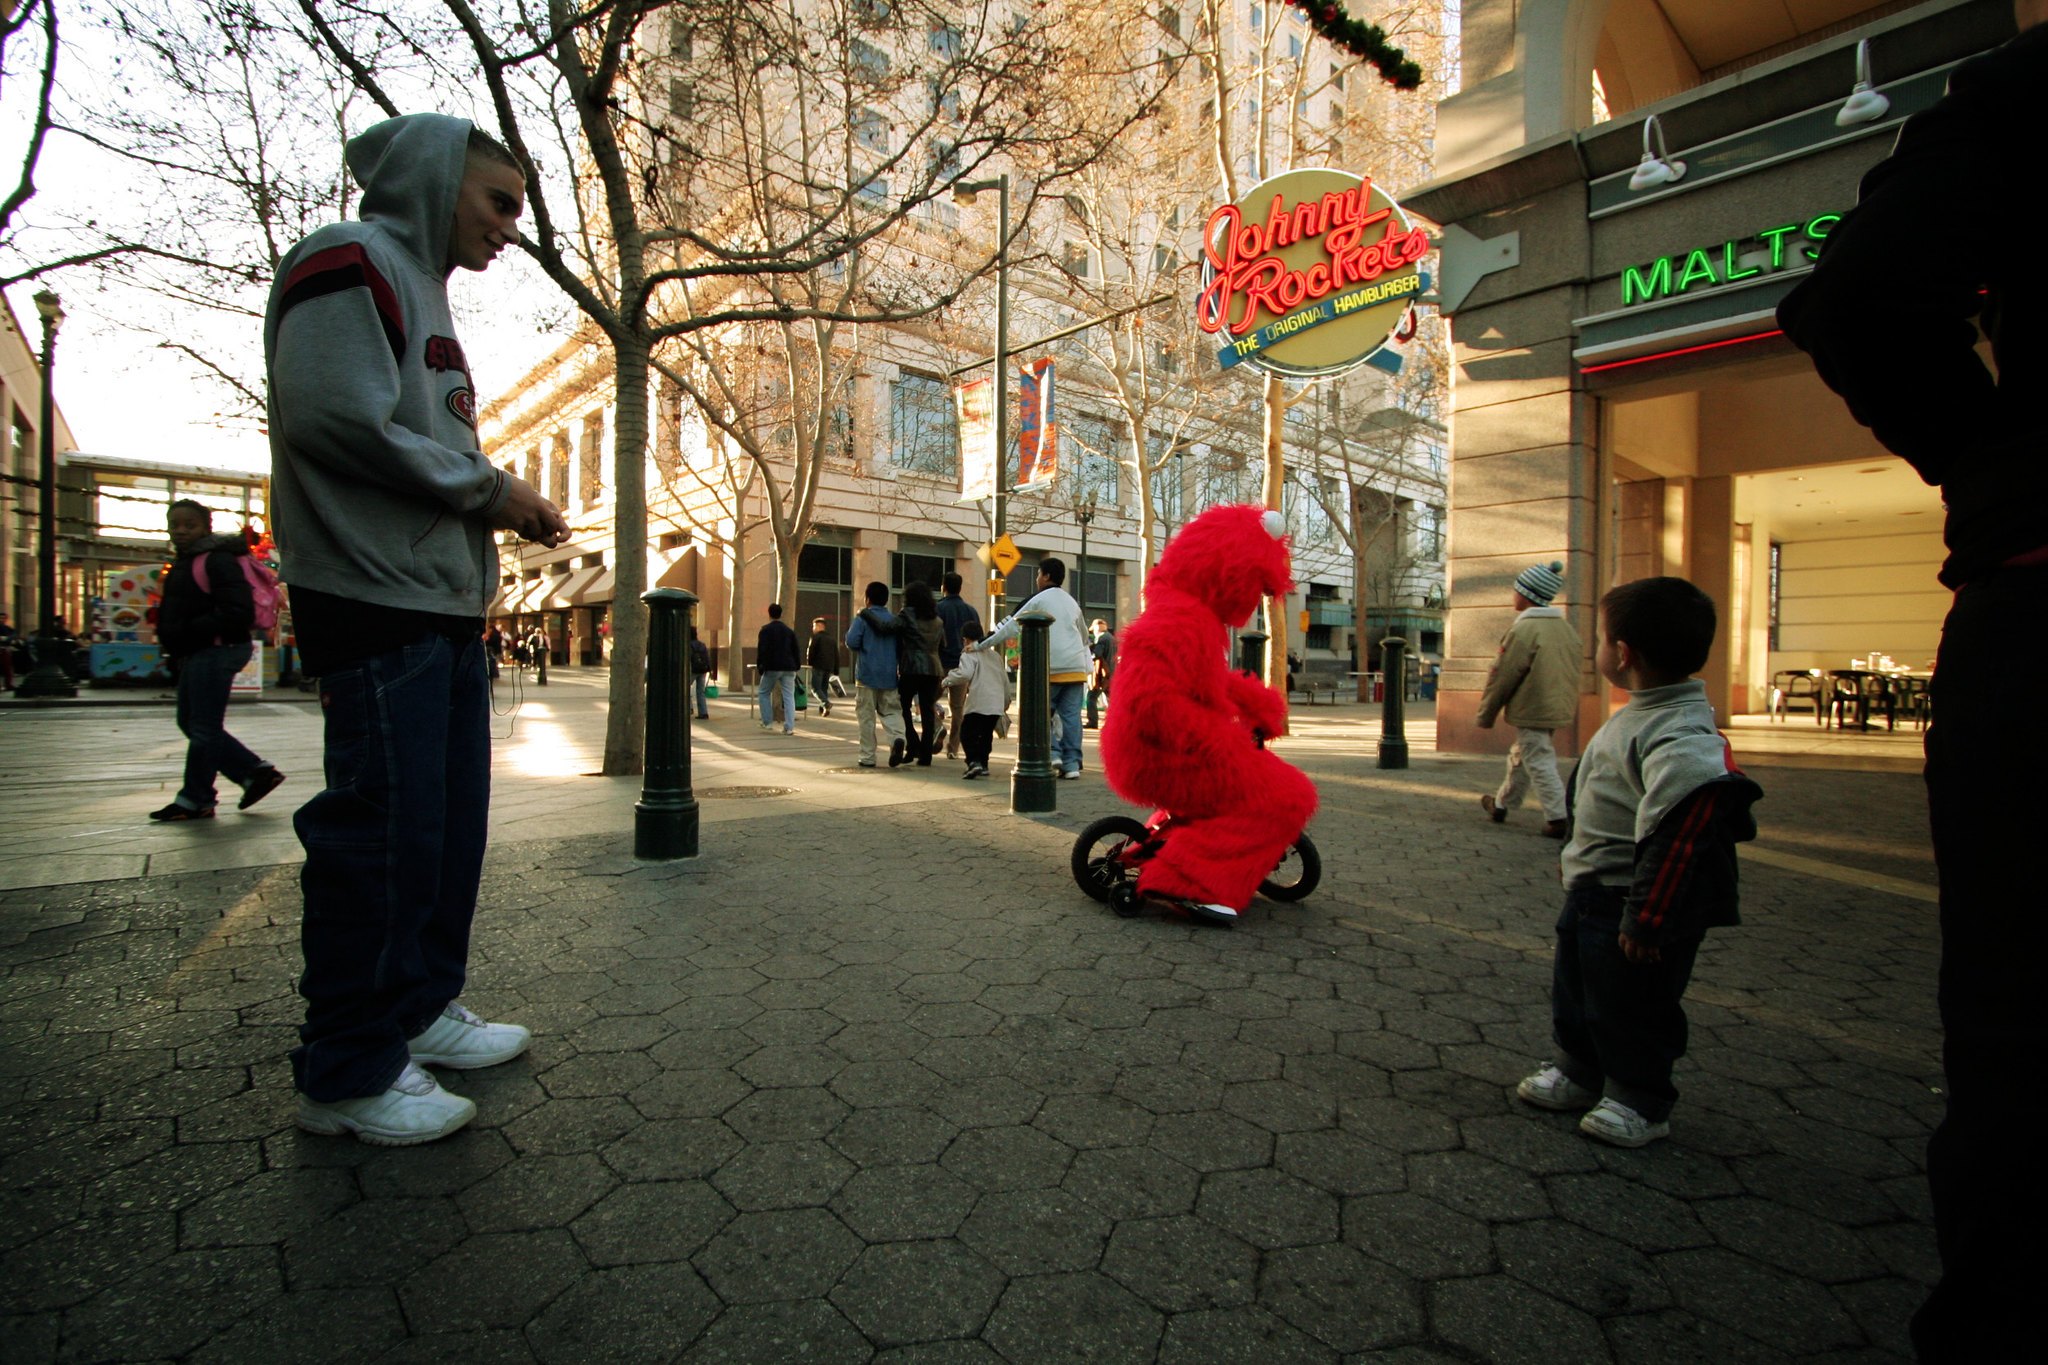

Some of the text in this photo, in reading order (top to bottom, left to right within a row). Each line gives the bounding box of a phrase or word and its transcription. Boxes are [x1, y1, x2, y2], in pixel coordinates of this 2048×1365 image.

[1197, 176, 1393, 333] Johnny
[1230, 219, 1430, 334] Rockets
[1621, 210, 1846, 306] MALTS
[1233, 274, 1421, 357] THE ORIGINAL HAMBURGER
